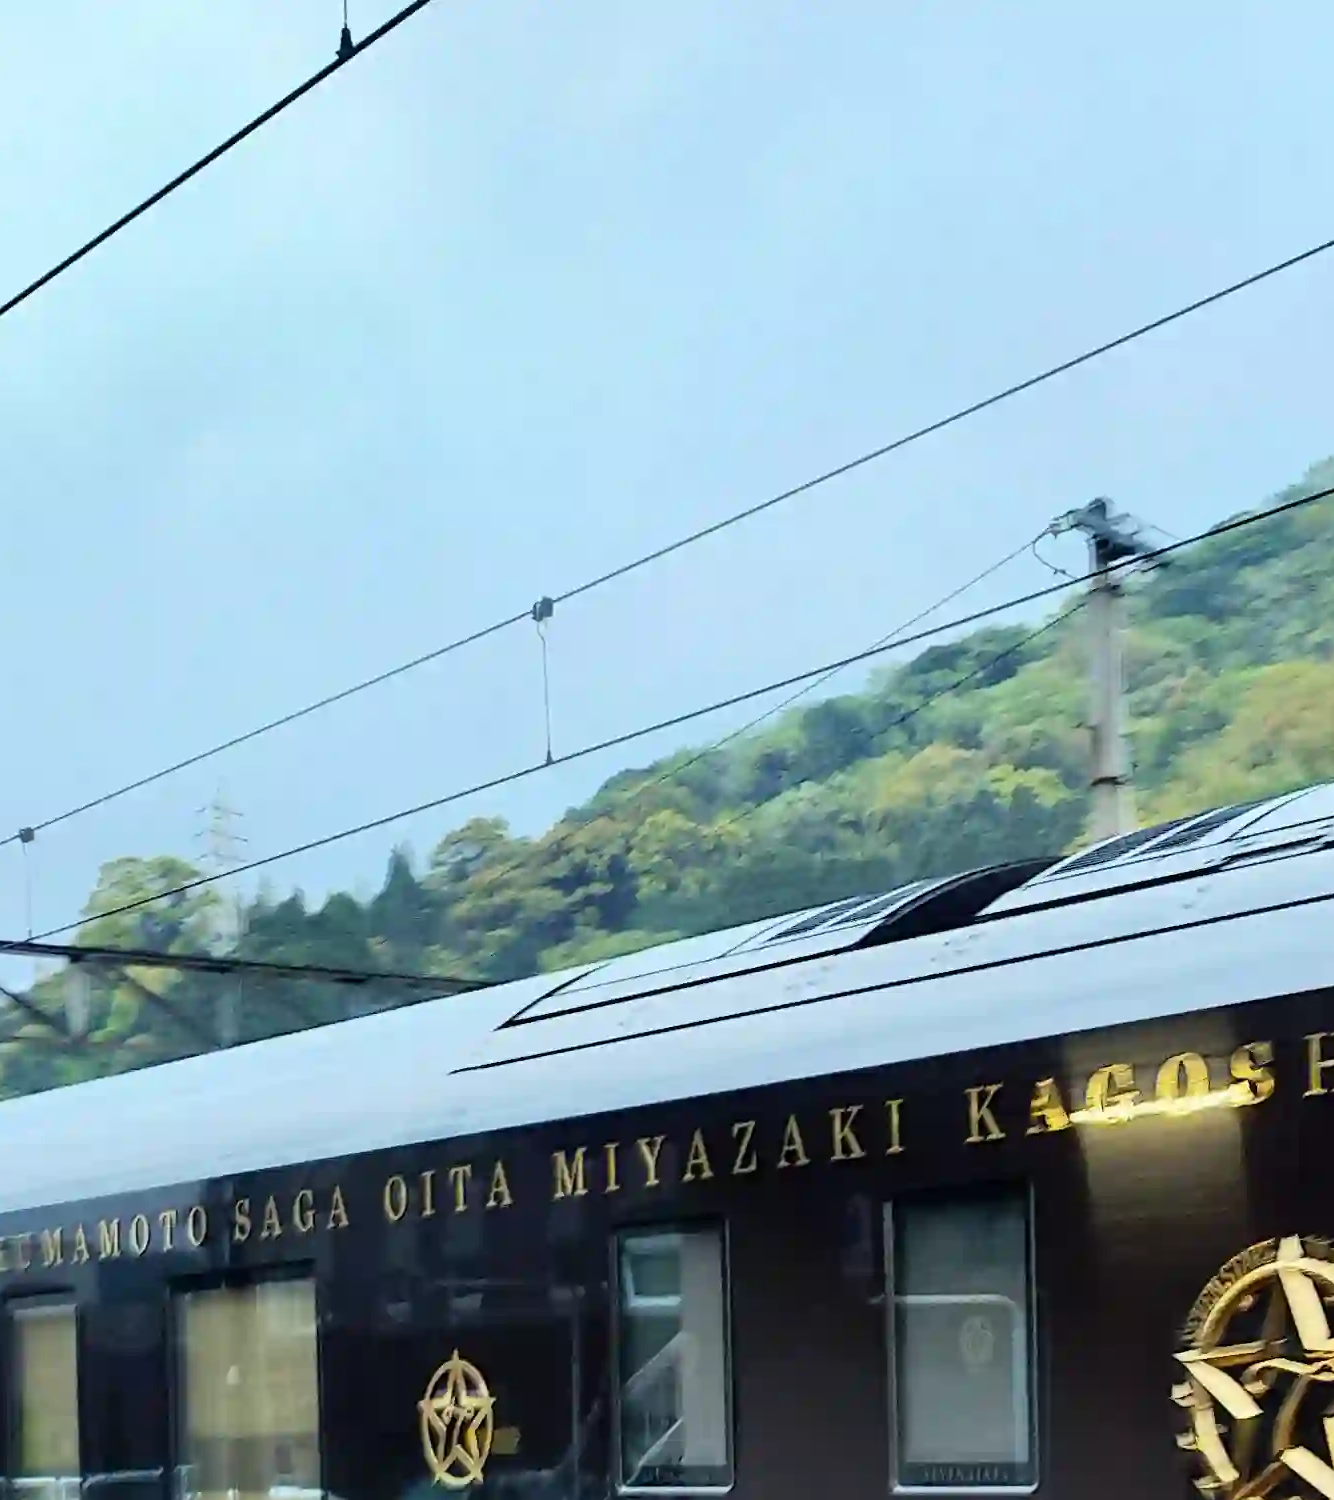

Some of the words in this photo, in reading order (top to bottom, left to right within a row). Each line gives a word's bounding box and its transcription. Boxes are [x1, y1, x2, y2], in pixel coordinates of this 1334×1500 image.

[233, 1184, 351, 1242] SAGA
[383, 1159, 514, 1222] OITA
[551, 1098, 906, 1200] MIYAZAKI
